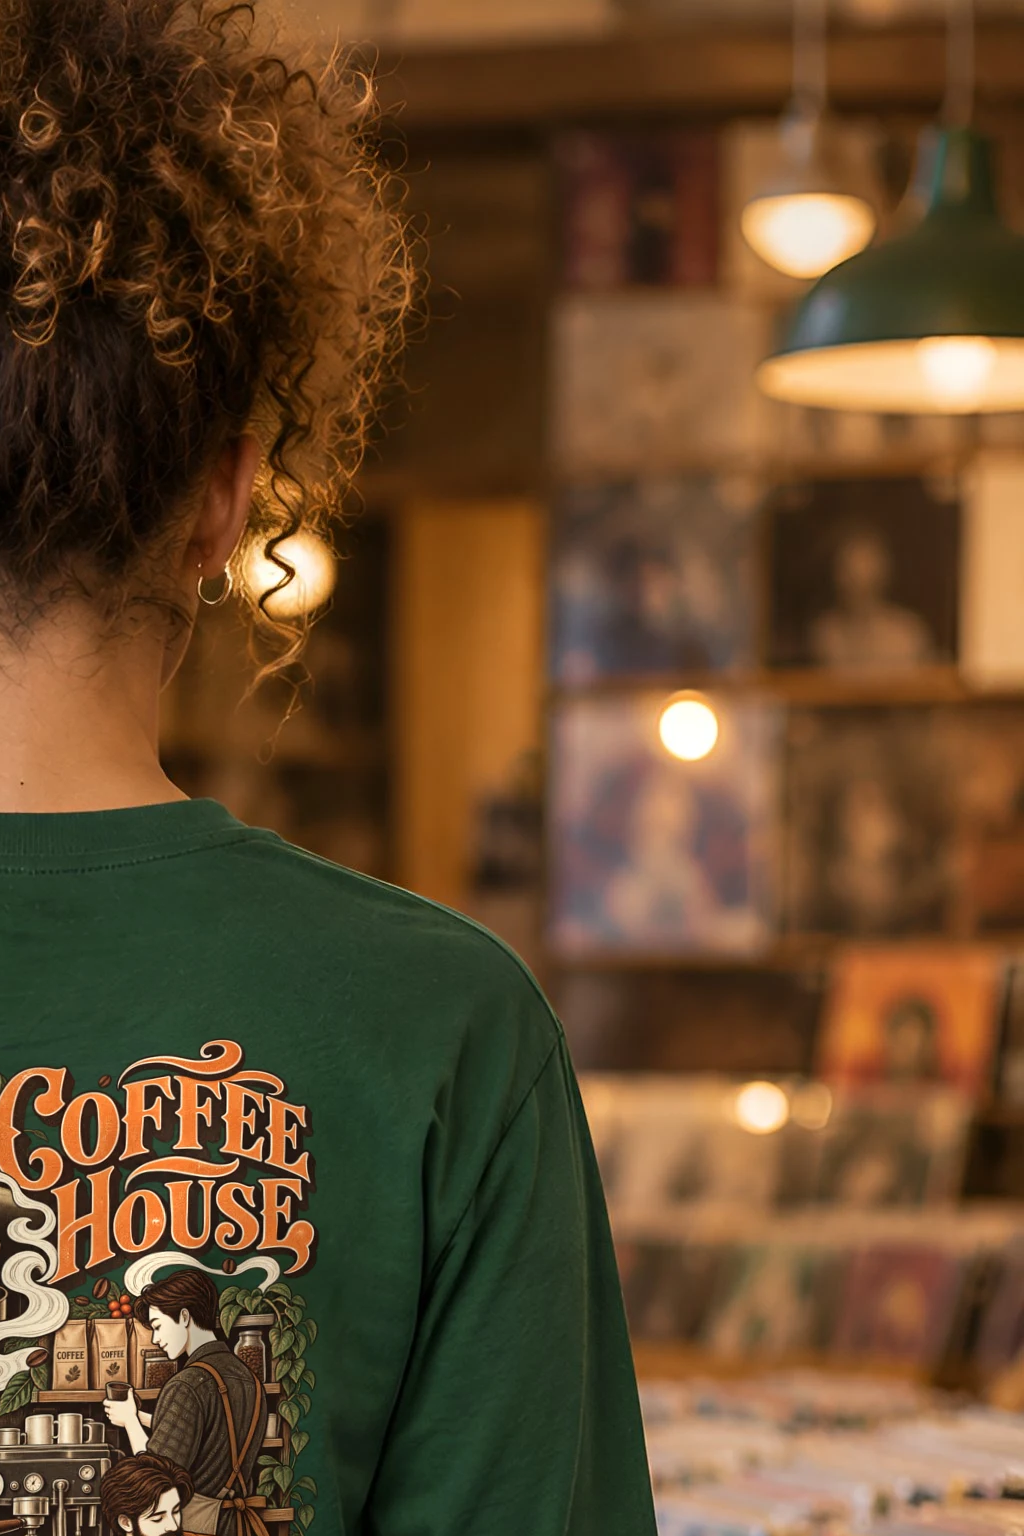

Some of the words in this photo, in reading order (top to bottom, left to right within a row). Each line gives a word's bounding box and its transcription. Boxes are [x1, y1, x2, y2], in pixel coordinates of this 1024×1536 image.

[46, 1158, 315, 1285] HOUSE
[56, 1351, 85, 1360] COFFEE
[100, 1350, 125, 1359] COFFEE
